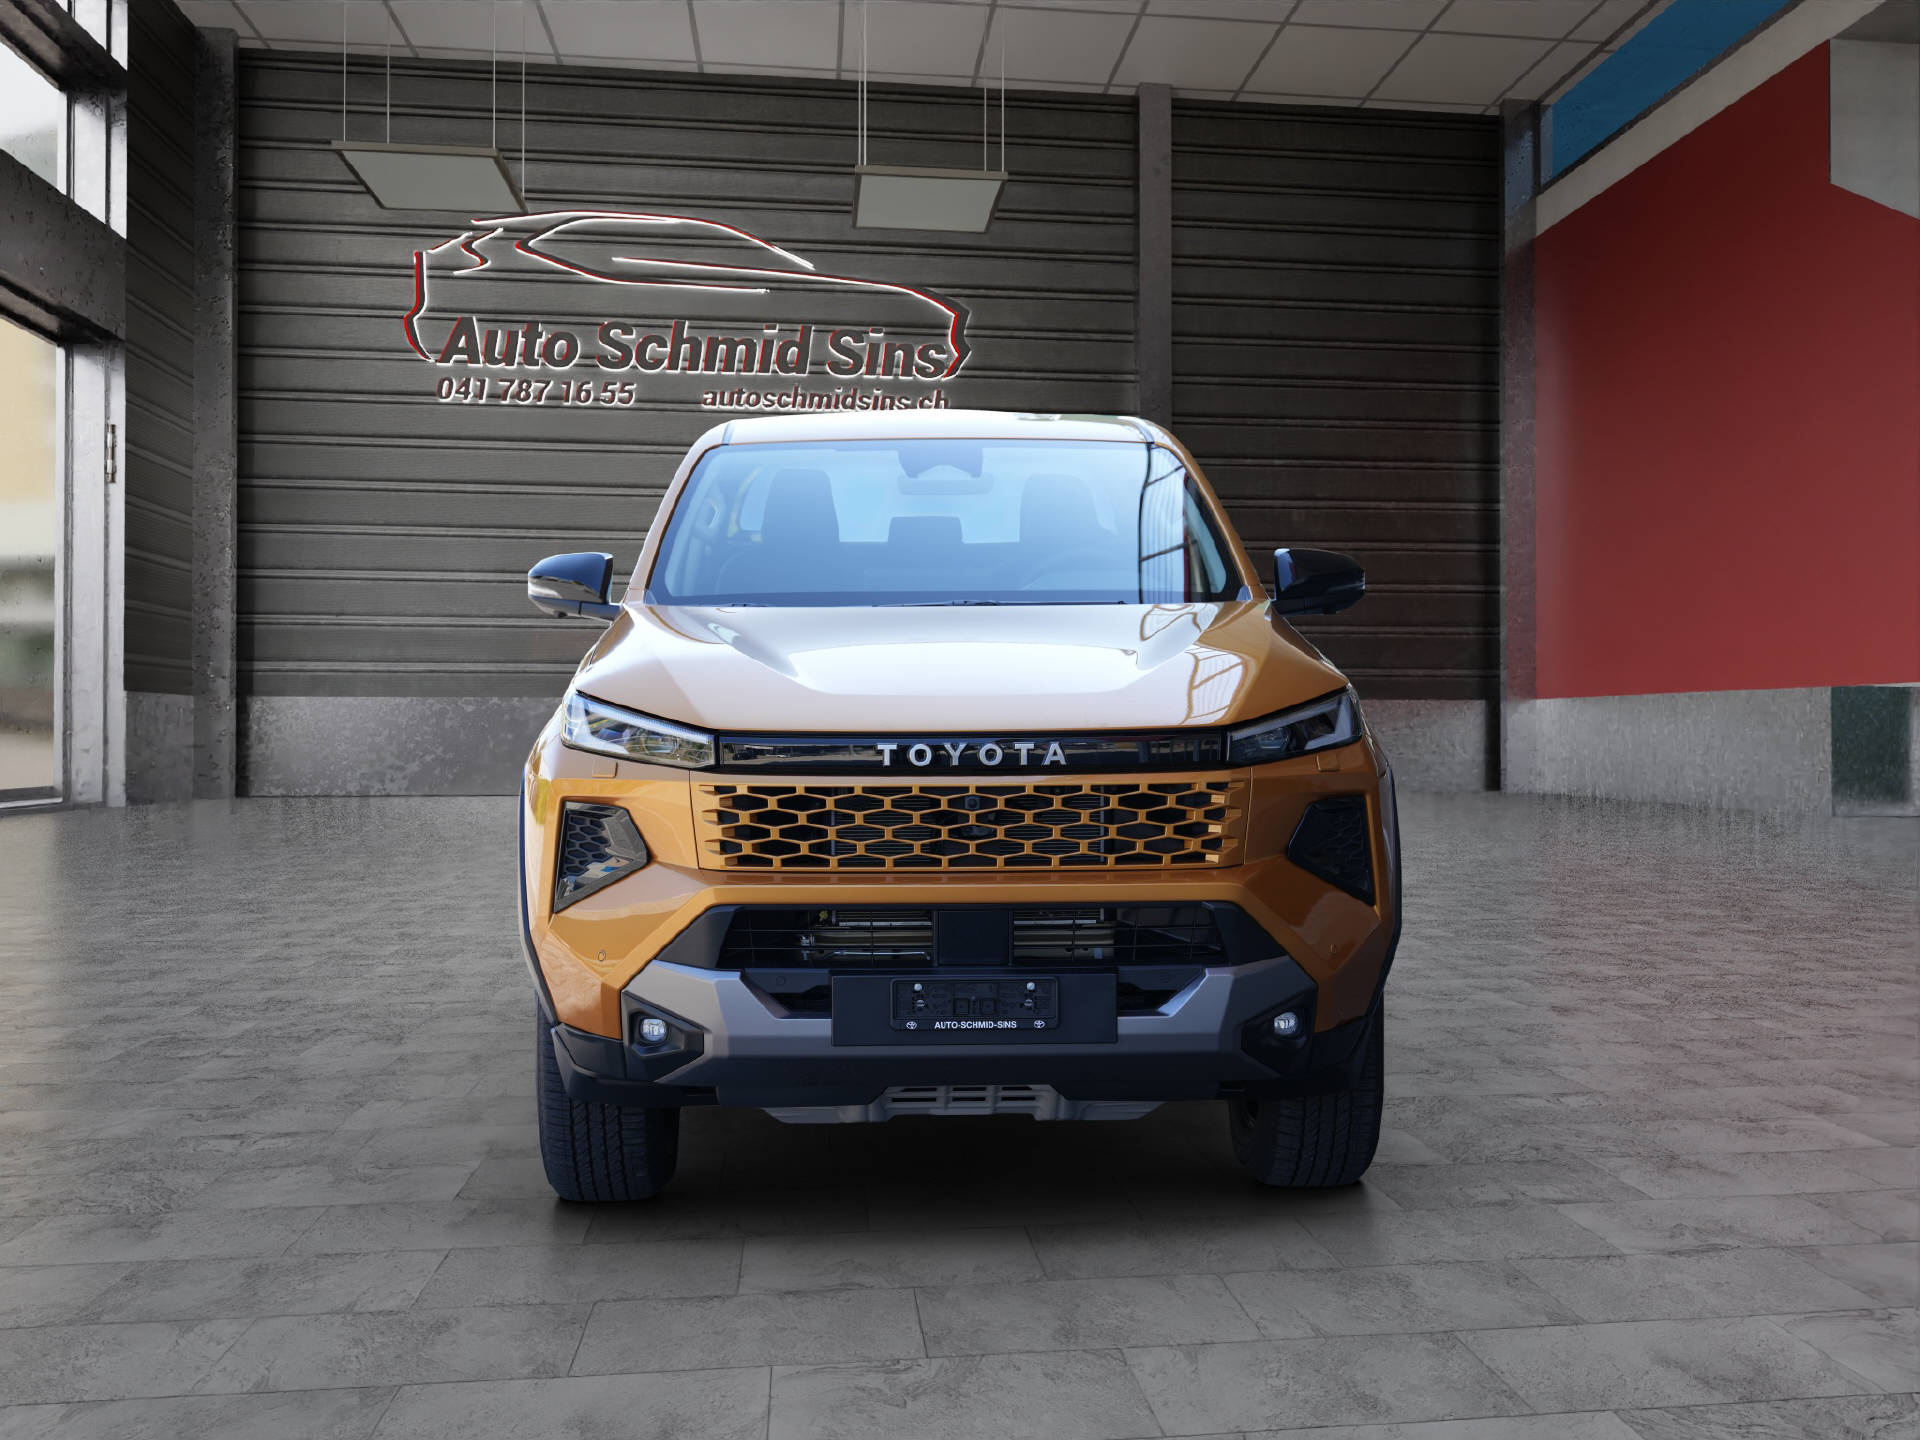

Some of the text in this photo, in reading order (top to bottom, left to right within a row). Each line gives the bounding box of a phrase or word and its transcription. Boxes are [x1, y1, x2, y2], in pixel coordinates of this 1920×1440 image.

[436, 315, 948, 380] Auto Schmid Sins
[435, 376, 637, 406] 041 787 16 55
[877, 742, 1067, 767] TOYOTA
[934, 1020, 1018, 1029] AUTO-SCHMID-SINS
